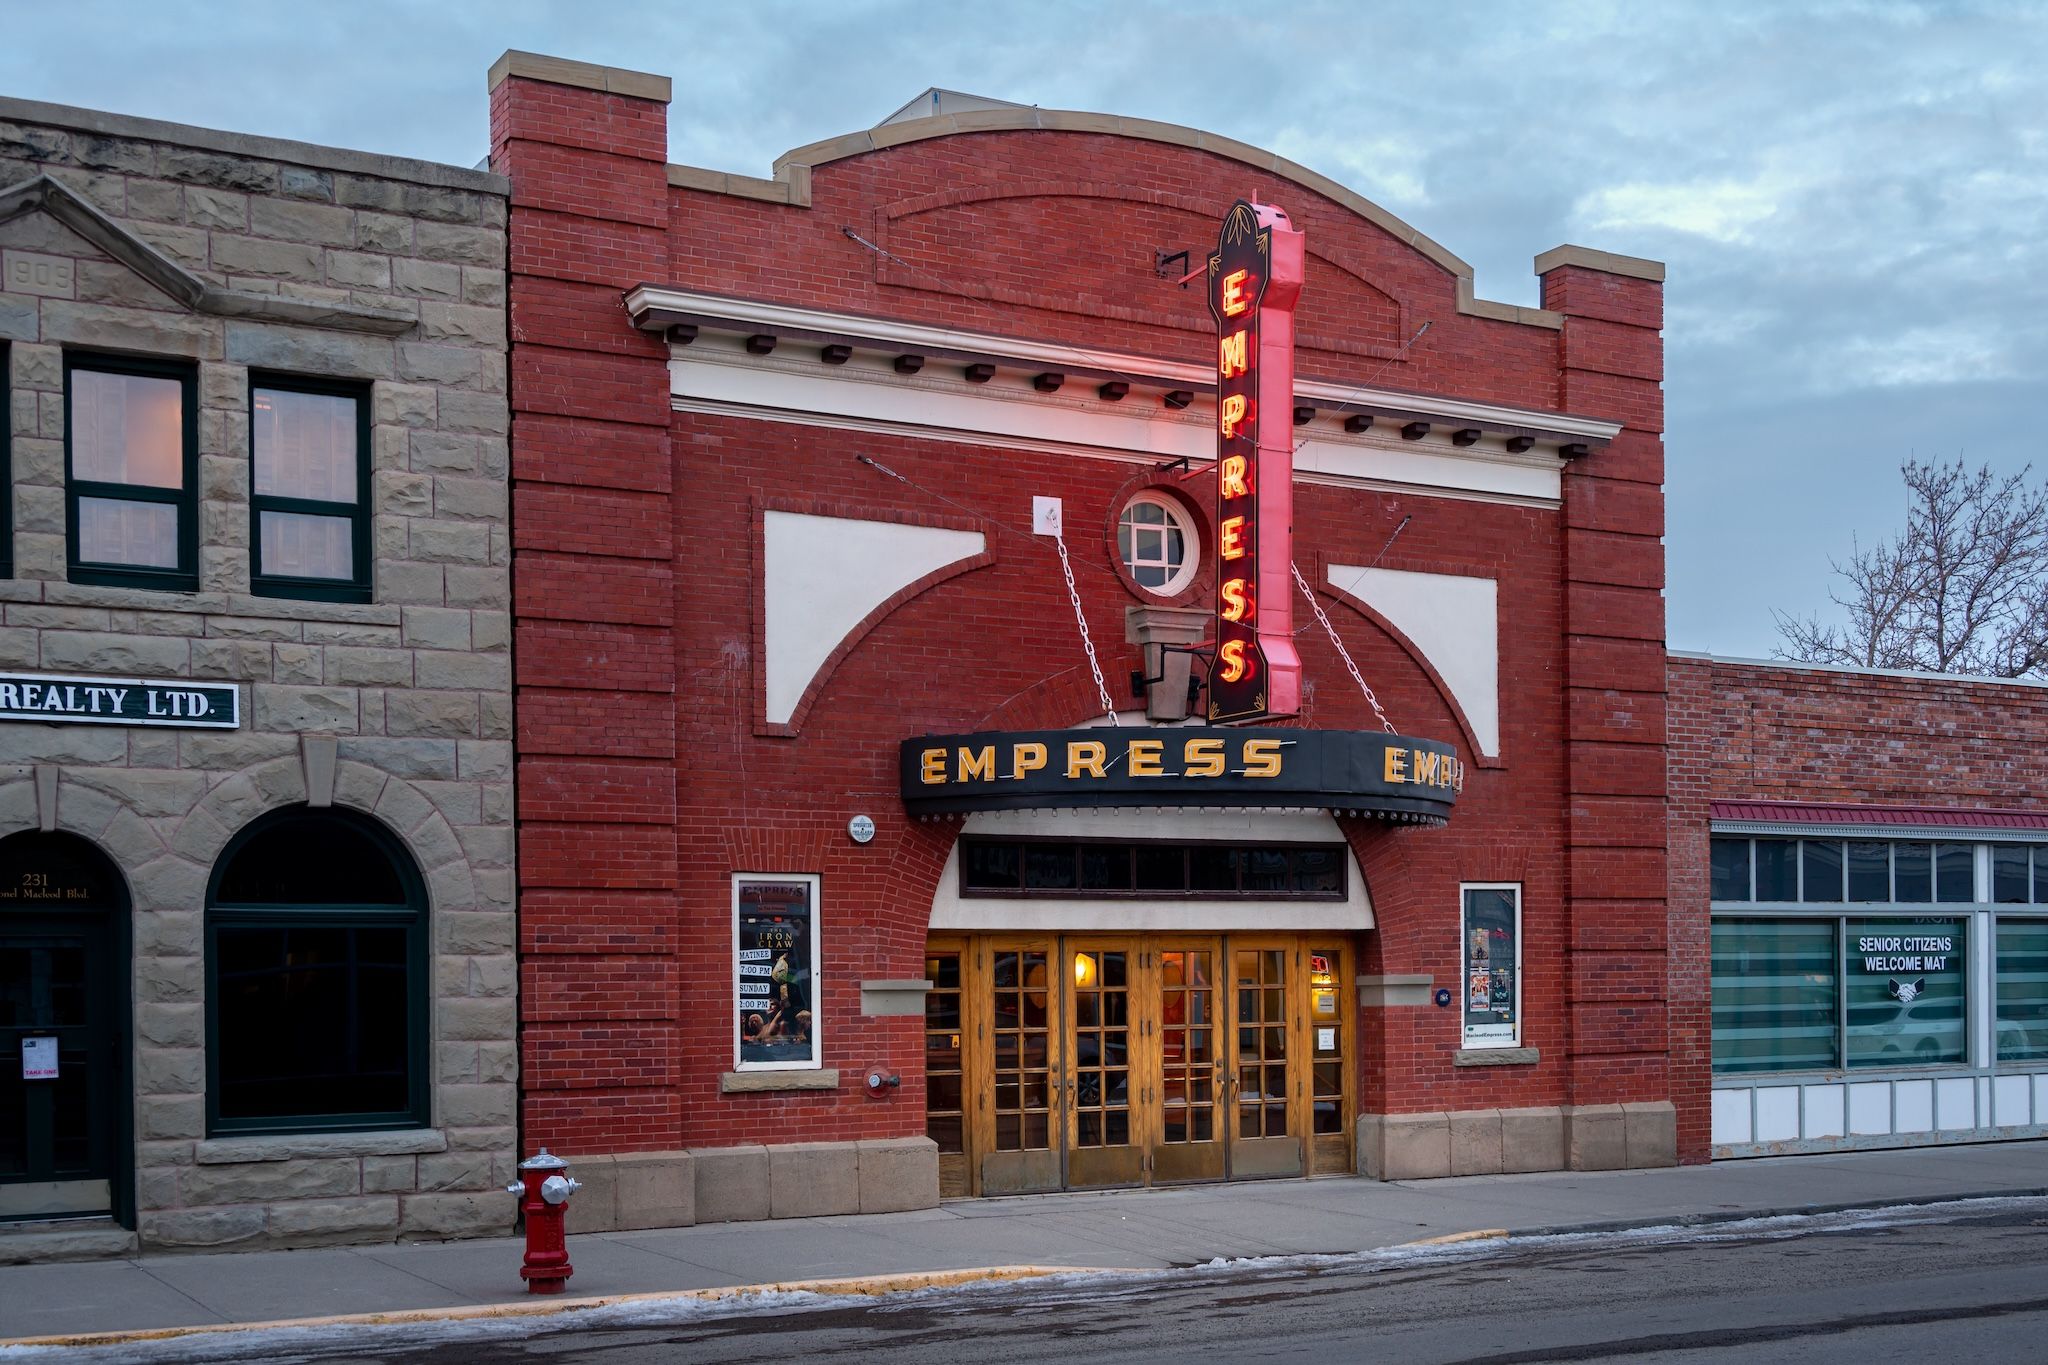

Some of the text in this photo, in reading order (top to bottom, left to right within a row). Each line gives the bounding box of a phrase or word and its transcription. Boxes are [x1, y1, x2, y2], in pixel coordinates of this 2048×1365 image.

[1221, 268, 1249, 684] EMPRESS
[0, 682, 216, 718] REALTY LTD.
[919, 738, 1284, 785] EMPRESS
[22, 873, 49, 887] 231
[23, 887, 61, 899] Macleod
[759, 932, 793, 941] IRON
[758, 940, 793, 949] CLAW
[1859, 936, 1952, 952] SENIOR CITIZENS
[740, 950, 770, 960] MATINEE
[1865, 956, 1946, 971] WELCOME MAT
[740, 966, 771, 975] 7:00 PM
[739, 984, 768, 993] SUNDAY
[739, 1000, 769, 1009] 2:00 PM
